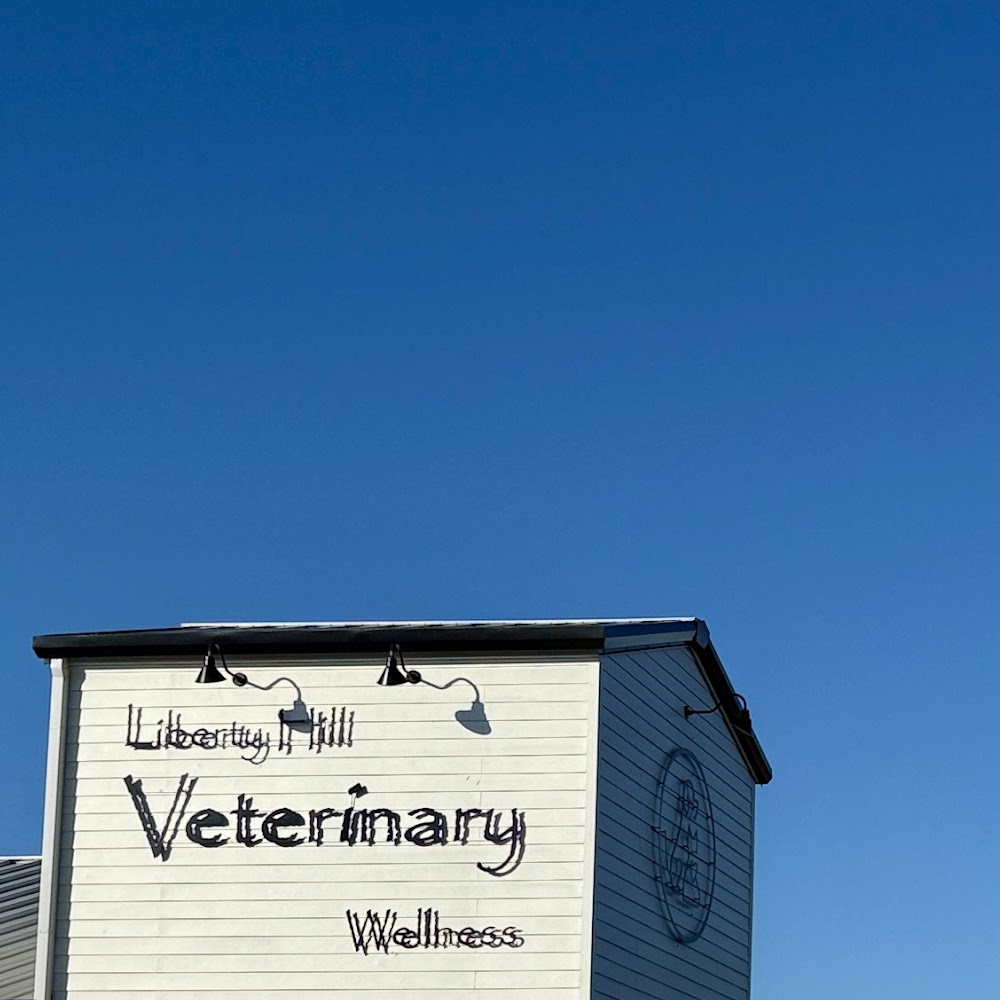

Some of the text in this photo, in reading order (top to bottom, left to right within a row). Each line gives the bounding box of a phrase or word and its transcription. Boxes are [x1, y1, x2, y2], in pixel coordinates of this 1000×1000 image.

[126, 703, 354, 764] Liberty Hill
[124, 773, 526, 877] Veterinary
[346, 907, 525, 956] Wellness
